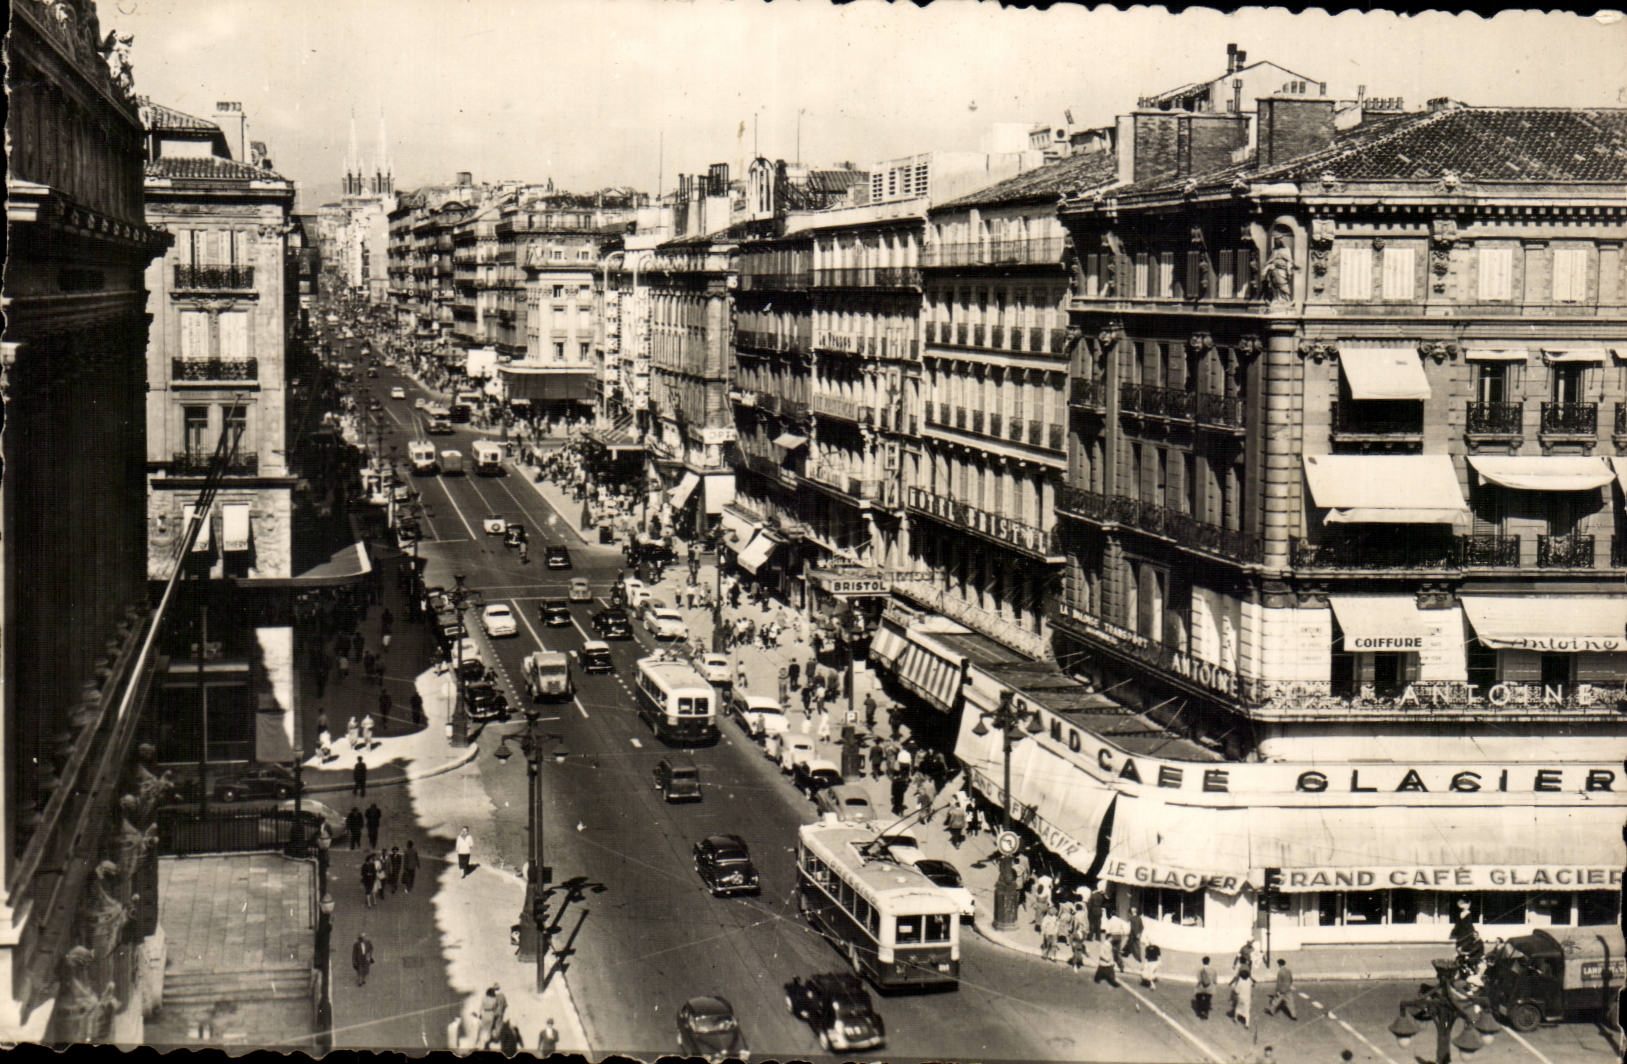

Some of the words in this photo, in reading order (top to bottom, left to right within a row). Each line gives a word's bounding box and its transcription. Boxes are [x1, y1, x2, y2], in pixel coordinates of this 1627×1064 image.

[968, 507, 1047, 555] BRISTOL
[833, 581, 887, 592] BRISTOL
[1354, 636, 1423, 648] COIFFURE
[1171, 652, 1239, 699] ANTOINE
[1400, 683, 1595, 707] ANTOINE
[1295, 768, 1616, 793] GLACIER
[1106, 860, 1127, 878] LE
[1134, 866, 1238, 891] GLACIER
[1388, 867, 1473, 886] CAFÉ
